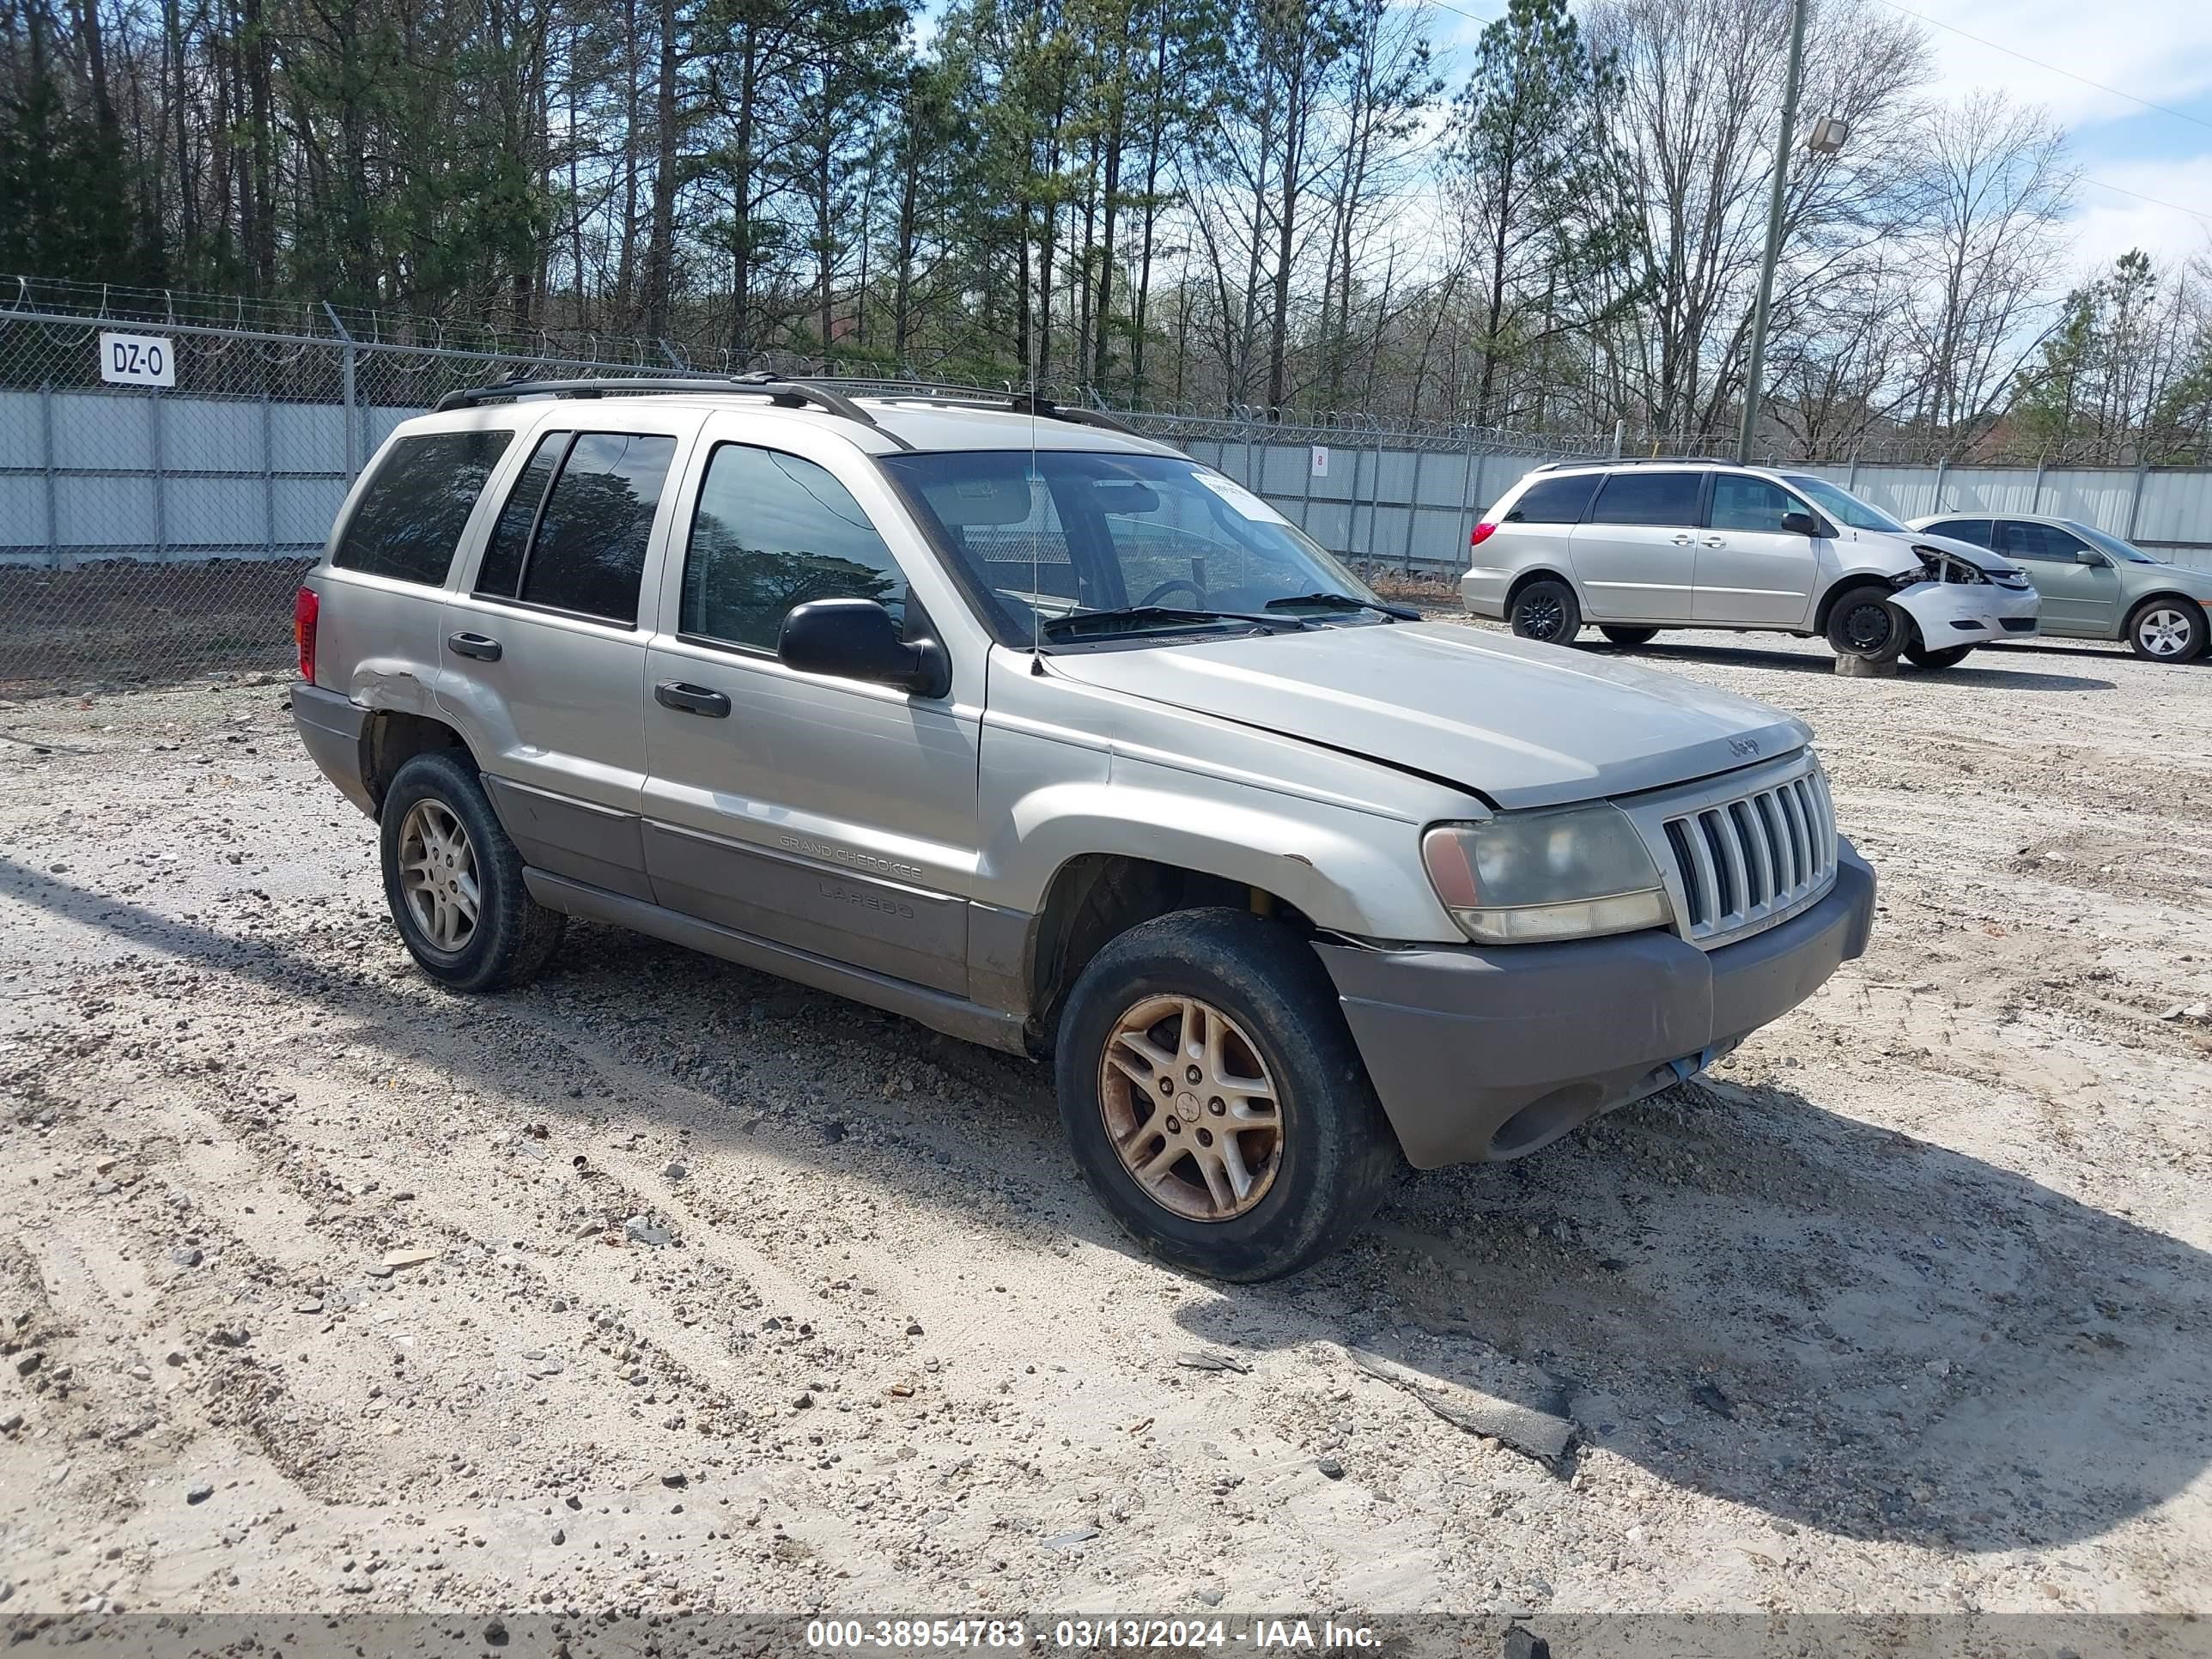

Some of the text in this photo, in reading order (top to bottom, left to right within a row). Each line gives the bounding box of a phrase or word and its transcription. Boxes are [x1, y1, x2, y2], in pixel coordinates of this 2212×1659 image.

[1317, 455, 1323, 466] 8
[1727, 738, 1759, 757] Jeep
[779, 836, 922, 880] GRAND CHEROKEE
[817, 881, 915, 920] LAREDO
